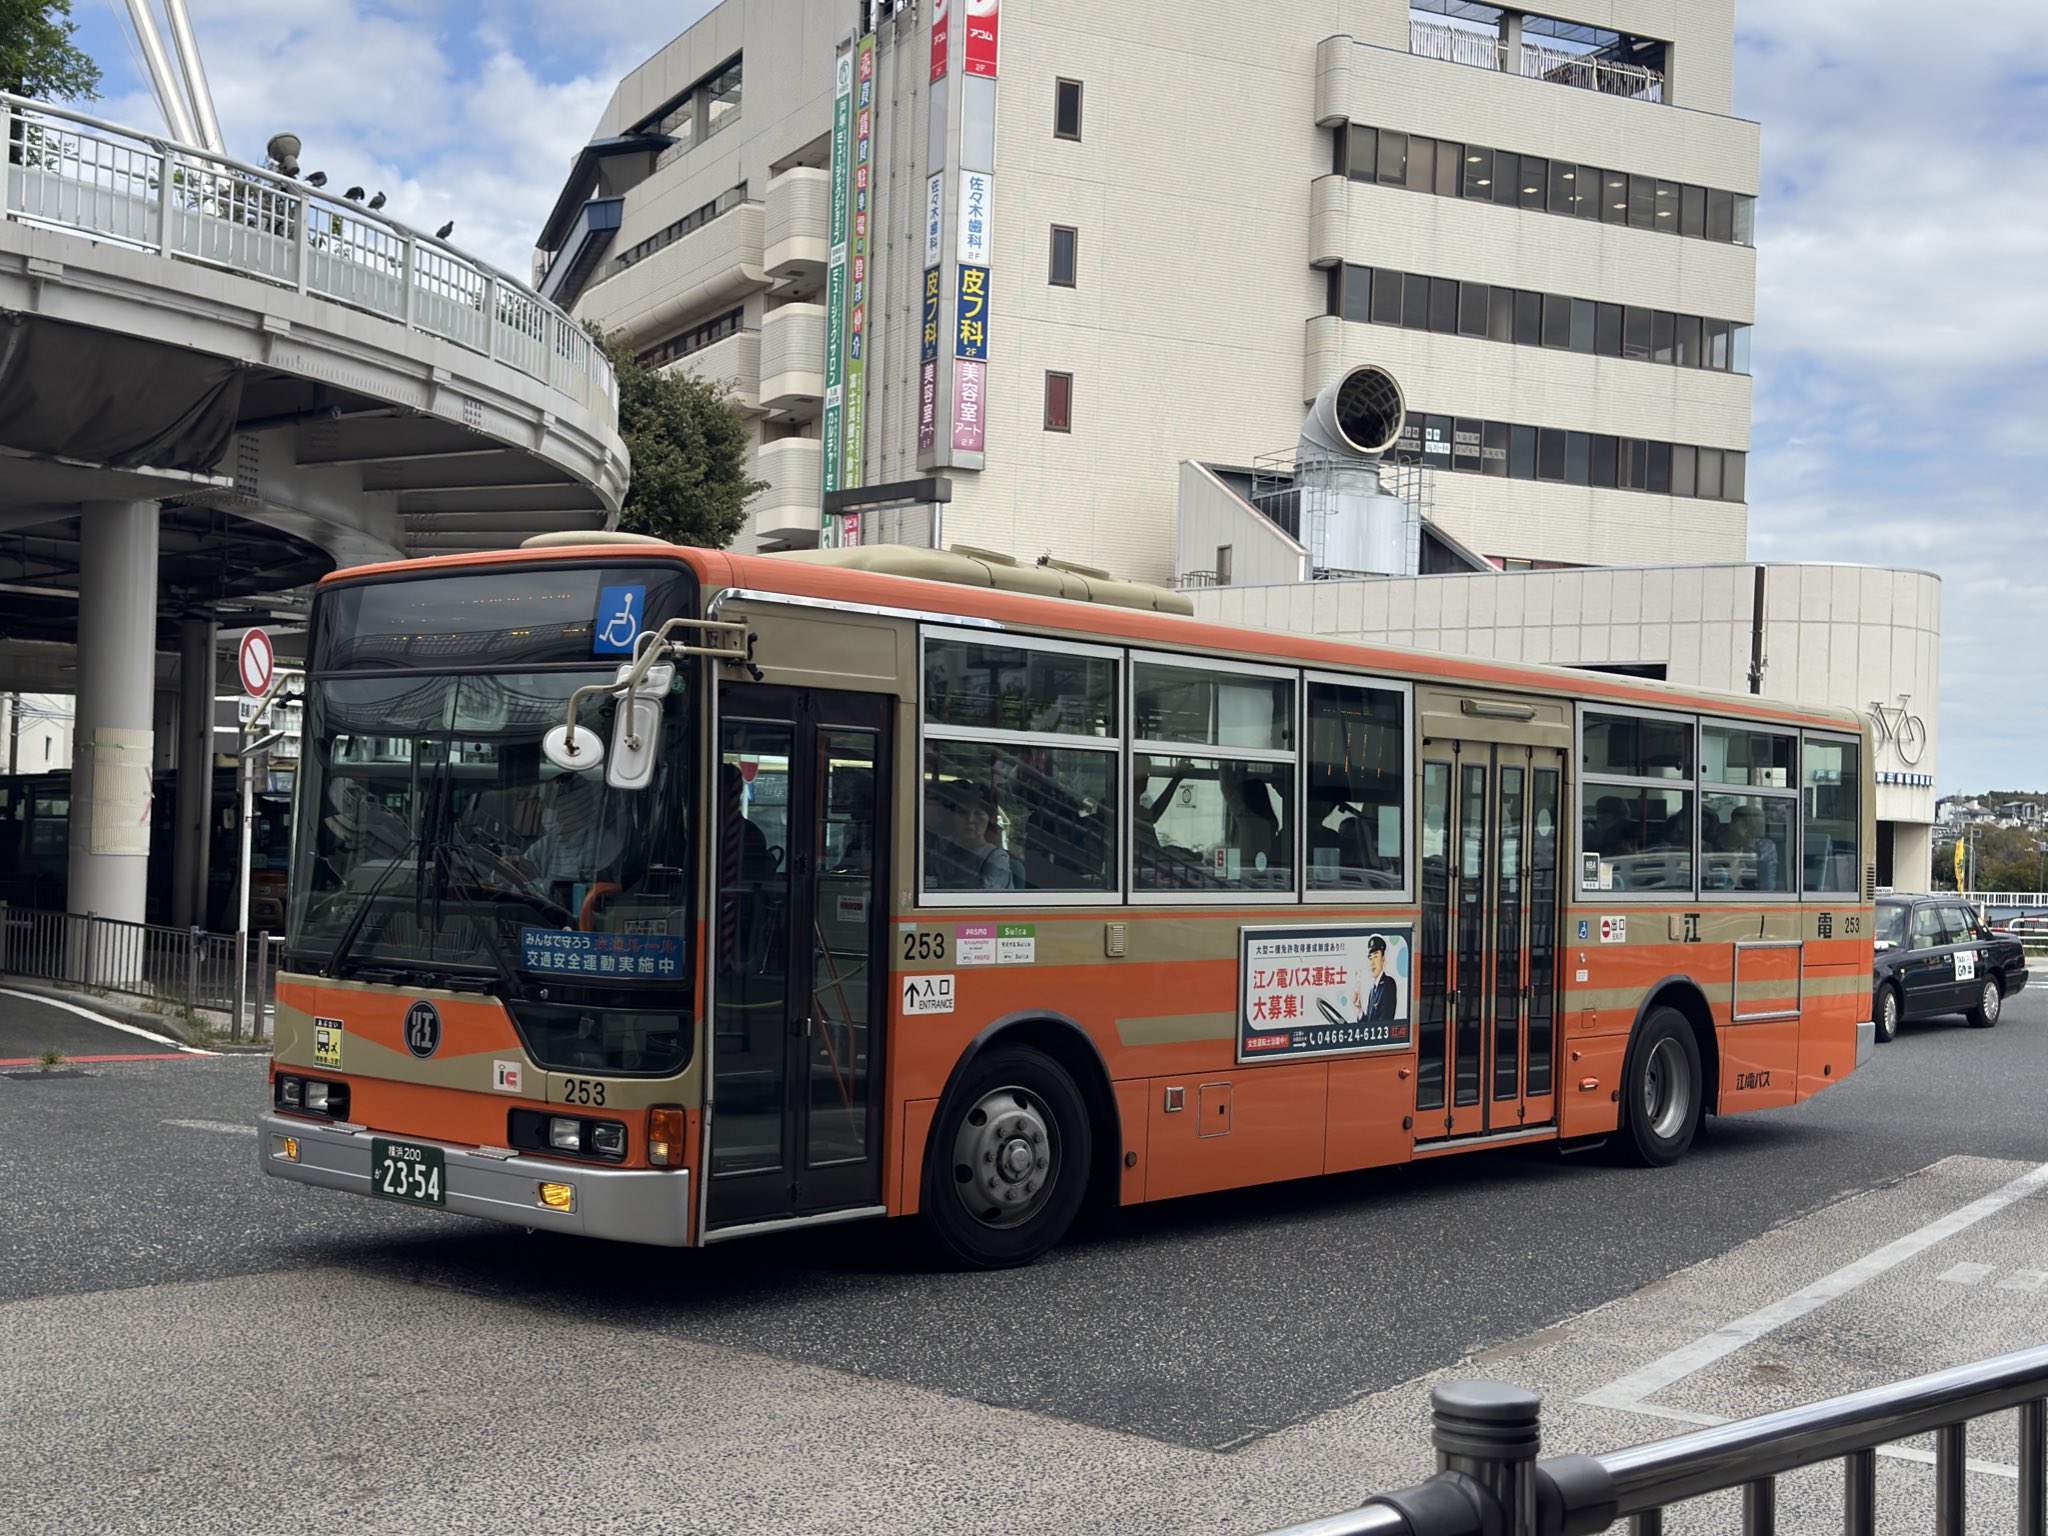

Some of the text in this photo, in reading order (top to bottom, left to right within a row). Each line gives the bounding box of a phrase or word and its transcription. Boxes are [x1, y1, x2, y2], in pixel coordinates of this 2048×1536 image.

[970, 28, 993, 41] アコム
[975, 63, 986, 71] 2F
[929, 179, 940, 250] 佐々木歯科
[968, 176, 984, 249] 佐々木歯科
[924, 270, 939, 349] 皮フ科
[960, 269, 984, 347] 皮フ科
[829, 268, 839, 385] ミュージックサロン
[965, 348, 976, 356] 2F
[923, 364, 934, 424] 美容室
[961, 363, 979, 422] 美容室
[920, 424, 934, 436] アート
[955, 423, 981, 436] アート
[961, 439, 974, 447] 2F
[965, 927, 987, 936] PASMO
[1005, 927, 1027, 935] Suica
[1844, 916, 1860, 934] 253
[525, 933, 676, 954] みんなで守ろう 交通ルール
[904, 933, 945, 960] 253
[1612, 932, 1623, 941] EXIT
[527, 951, 675, 974] 交通安全運動実施中
[1253, 966, 1347, 989] 江ノ電バス運転士
[923, 979, 950, 997] 入口
[919, 999, 953, 1010] ENTRANCE
[1253, 994, 1304, 1021] 大募集!
[1317, 1026, 1389, 1045] 0466-24-6123
[564, 1079, 606, 1106] 253
